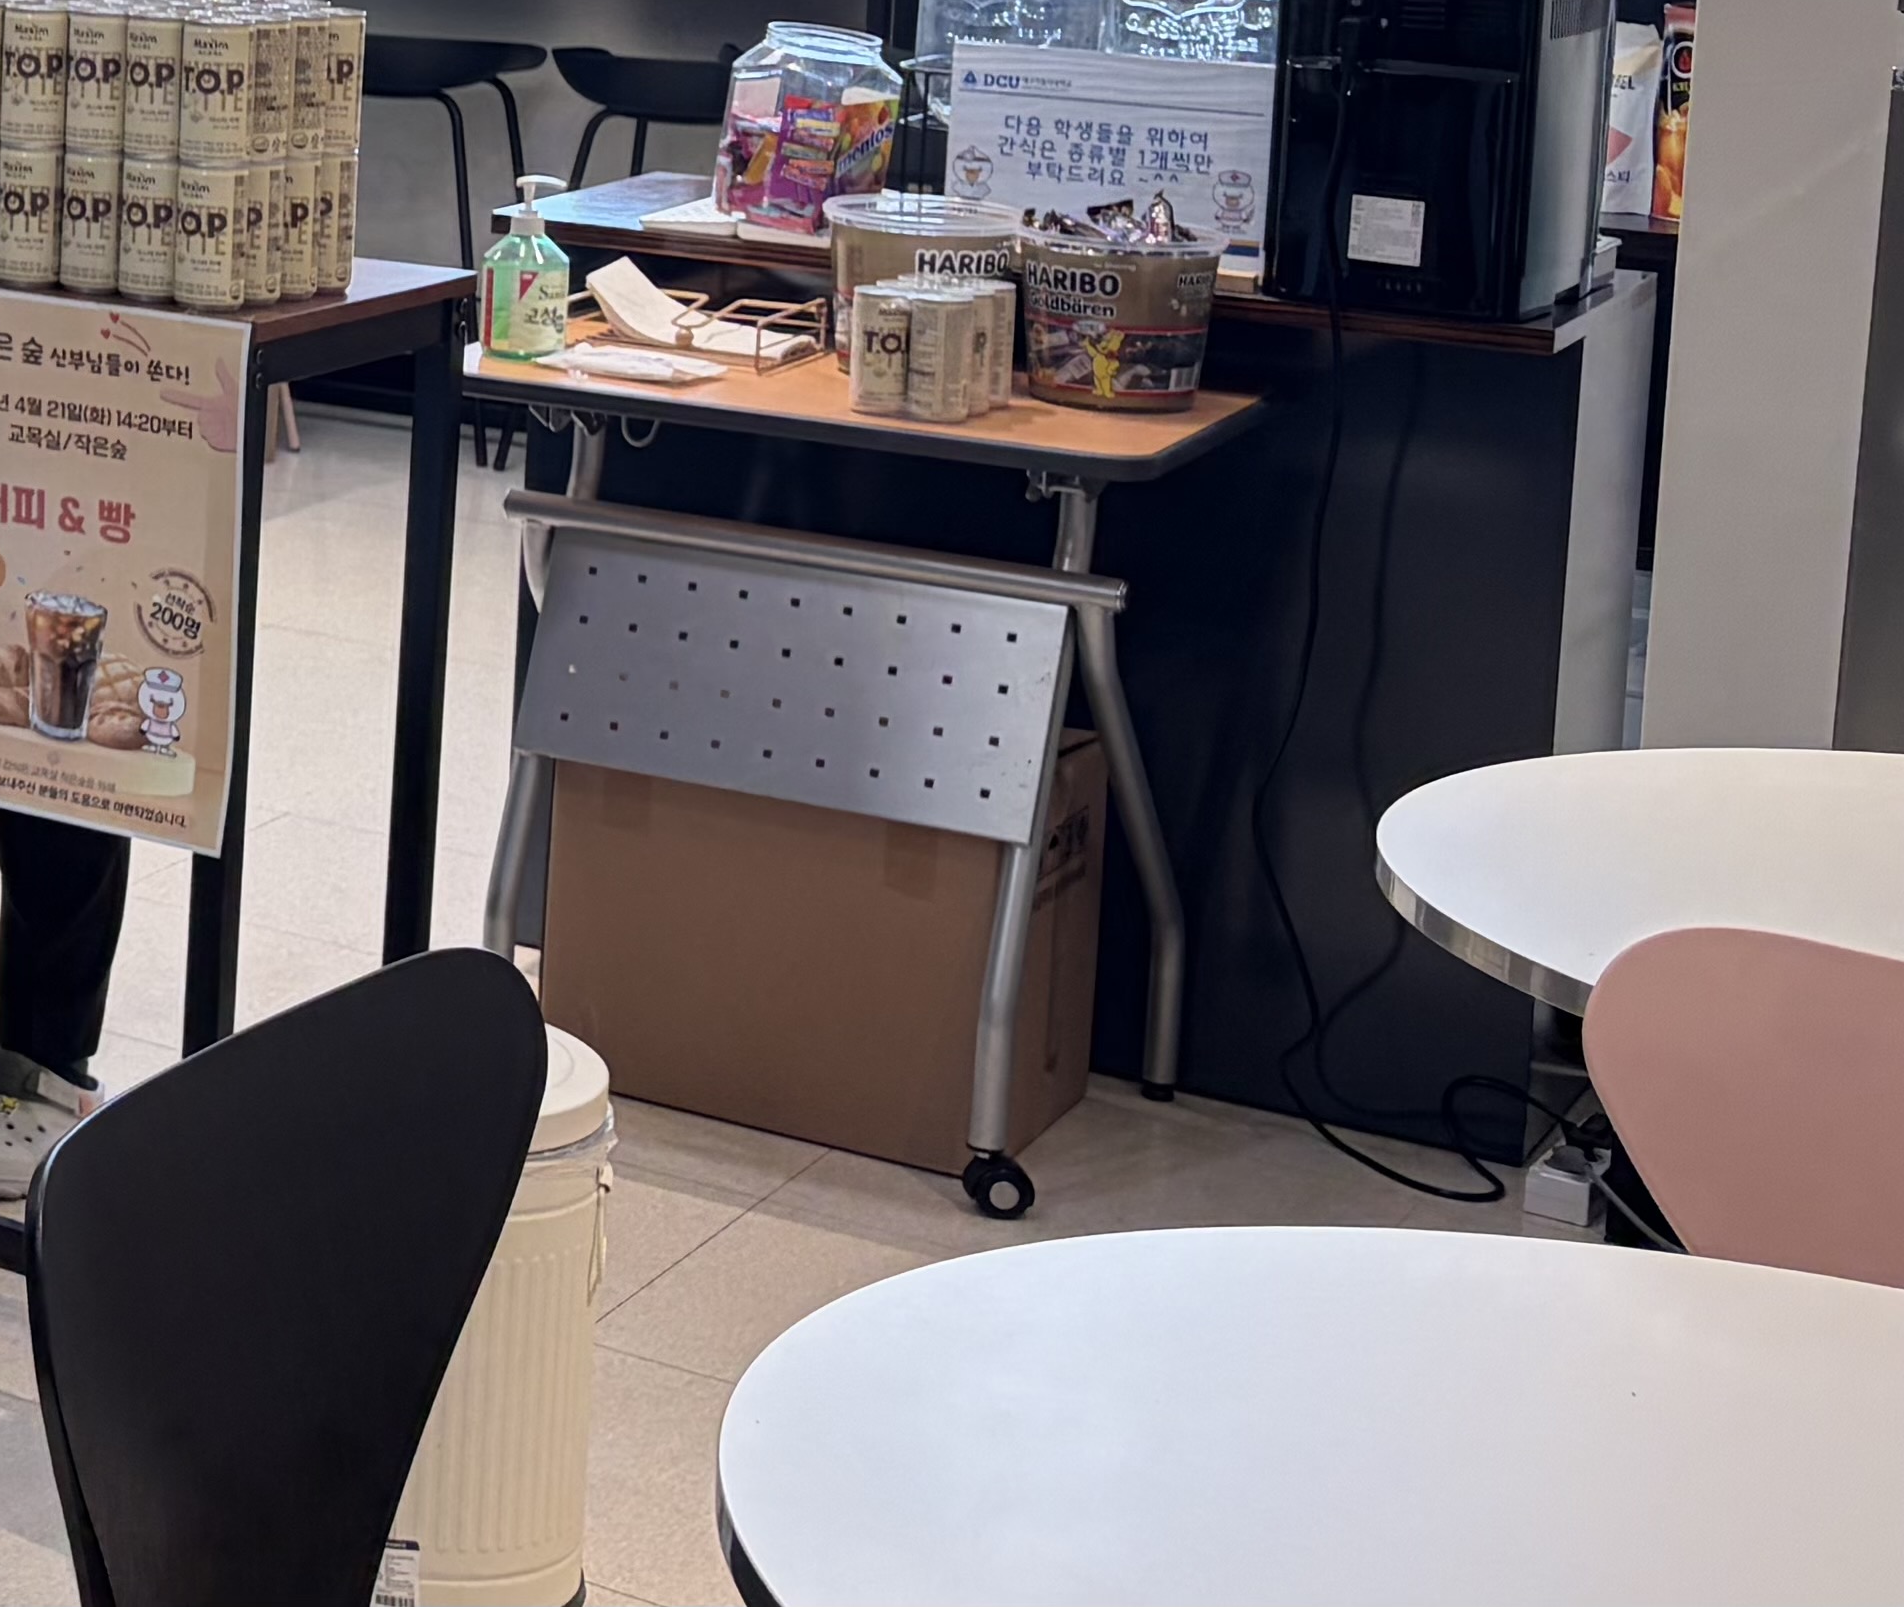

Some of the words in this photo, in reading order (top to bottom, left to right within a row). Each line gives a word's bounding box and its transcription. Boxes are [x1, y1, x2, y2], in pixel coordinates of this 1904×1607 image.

[194, 38, 230, 51] Maxim
[5, 50, 64, 80] T.O.P
[184, 65, 245, 96] T.O.P
[983, 73, 1021, 89] DCU
[837, 121, 893, 173] mentos
[1054, 118, 1134, 146] 학생들을
[1146, 126, 1209, 152] 위하여
[997, 135, 1057, 160] 간식은
[1068, 142, 1126, 168] 종류별
[1138, 149, 1214, 176] 1개씩만
[917, 250, 1010, 276] HARIBO
[1025, 261, 1122, 297] HARIBO
[21, 336, 44, 367] 숲
[50, 347, 141, 377] 신부님들이
[863, 330, 909, 355] T.O.
[14, 397, 43, 418] 4월
[46, 400, 113, 427] 21일(화)
[115, 409, 194, 441] 14:20부터
[7, 423, 129, 462] 교목실/작은숲
[57, 496, 87, 536] &
[98, 498, 137, 546] 빵
[149, 602, 202, 640] 200명
[70, 791, 111, 811] 도움으로
